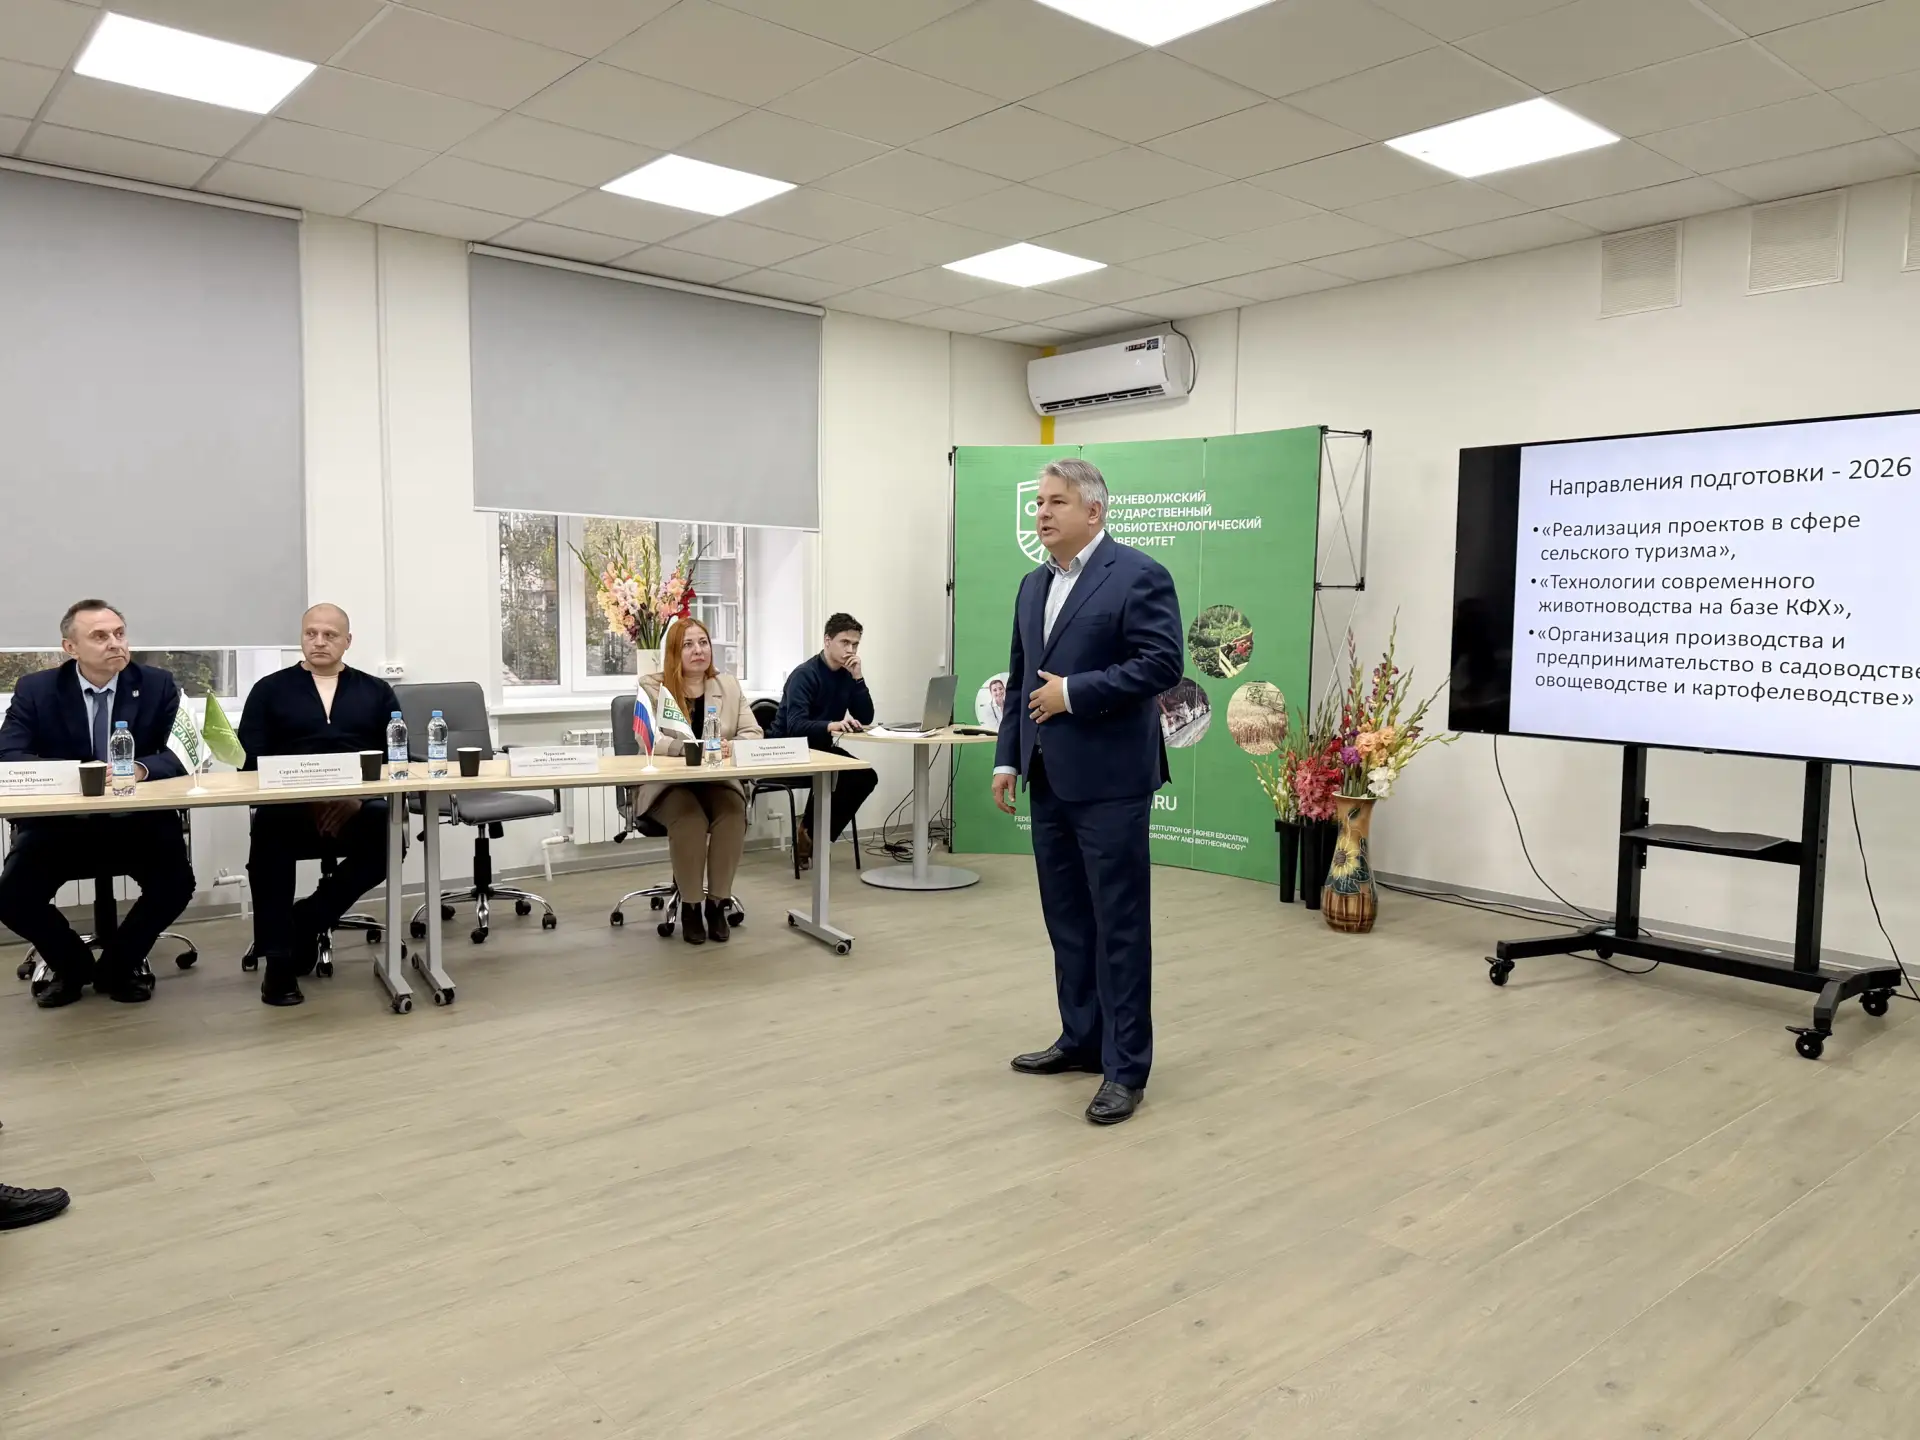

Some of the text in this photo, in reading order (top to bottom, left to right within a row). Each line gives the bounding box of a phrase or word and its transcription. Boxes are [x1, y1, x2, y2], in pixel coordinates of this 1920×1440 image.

[1550, 475, 1683, 499] Направления
[1690, 466, 1824, 491] подготовки
[1848, 456, 1912, 480] 2026
[1108, 490, 1206, 505] РХНЕВОЛЖСКИЙ
[1106, 504, 1211, 520] СУДАРСТВЕННЫЙ
[1106, 516, 1262, 534] РОБИОТЕХНОЛОГИЧЕСКИЙ
[1542, 511, 1861, 538] «Реализация проектов в сфере
[1113, 536, 1176, 547] ВЕРСИТЕТ
[1540, 545, 1736, 563] сельского туризма»,
[1539, 574, 1815, 593] «Технологии современного
[1538, 597, 1852, 620] животноводства на базе КФХ»,
[1537, 626, 1845, 651] «Организация производства и
[1536, 652, 1754, 673] предпринимательство
[1761, 660, 1773, 673] в
[1535, 675, 1914, 708] овощеводстве и картофелеводстве»
[1181, 836, 1195, 844] AND
[1192, 829, 1215, 838] HIGHER
[1215, 832, 1249, 843] EDUCATION
